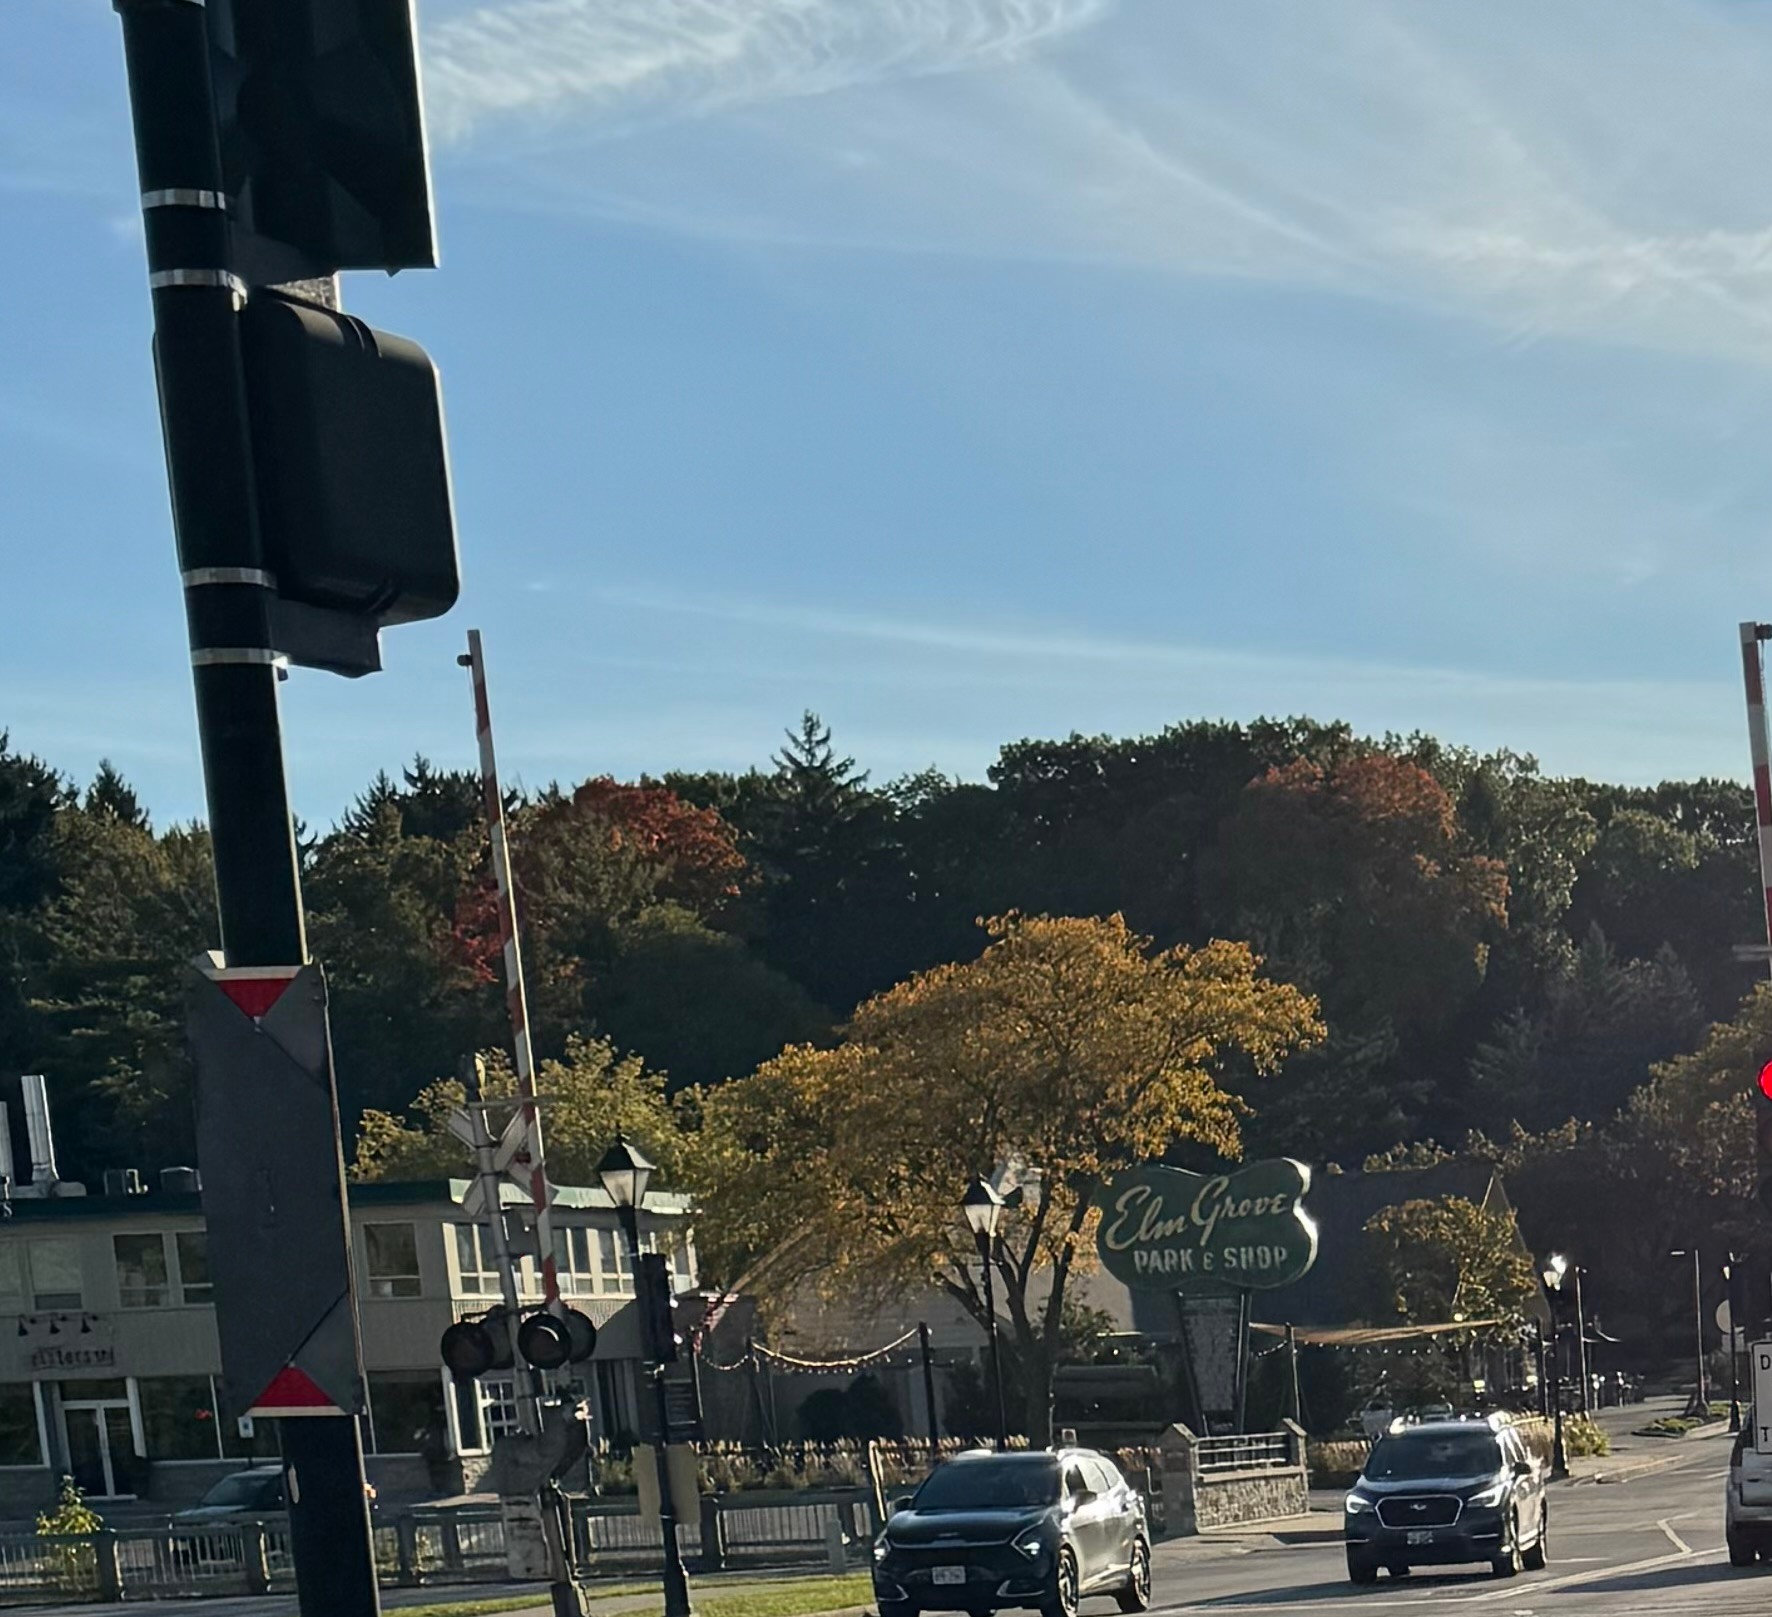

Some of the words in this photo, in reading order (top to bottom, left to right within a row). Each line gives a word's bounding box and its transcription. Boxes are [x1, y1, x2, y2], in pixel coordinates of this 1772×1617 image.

[1105, 1185, 1189, 1250] Elm
[1190, 1175, 1289, 1247] Grove
[1133, 1248, 1194, 1274] PARK
[1223, 1245, 1288, 1270] SHOP
